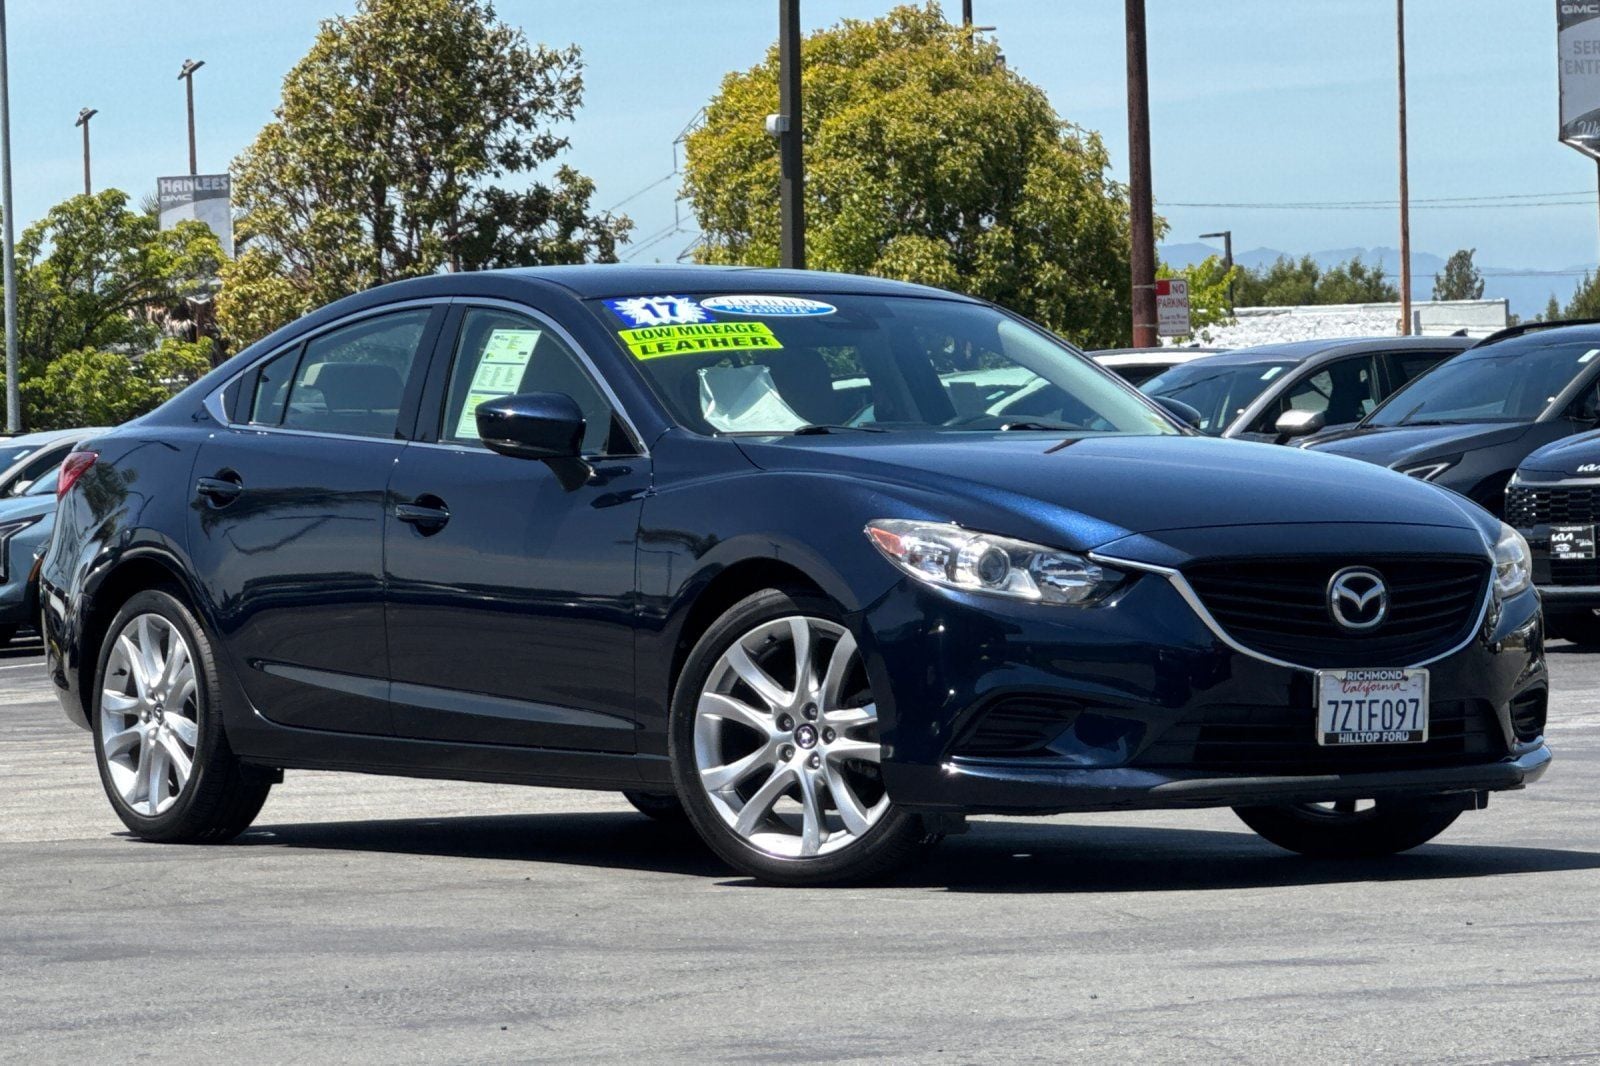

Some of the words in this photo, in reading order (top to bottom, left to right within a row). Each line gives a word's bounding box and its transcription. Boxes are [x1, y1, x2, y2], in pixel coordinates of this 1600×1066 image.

[1561, 4, 1599, 14] GMC
[160, 177, 229, 194] HANLEES
[160, 193, 193, 202] GMC
[1171, 283, 1185, 294] NO
[1157, 297, 1188, 308] PARKING
[641, 301, 678, 319] 17
[631, 327, 672, 341] LOW
[678, 323, 761, 336] MILEAGE
[640, 336, 769, 355] LEATHER
[1347, 670, 1403, 681] RICHMOND
[1341, 681, 1407, 697] California
[1327, 698, 1420, 731] 7ZTF097
[1338, 731, 1379, 743] HILLTOP
[1382, 731, 1409, 742] FORD
